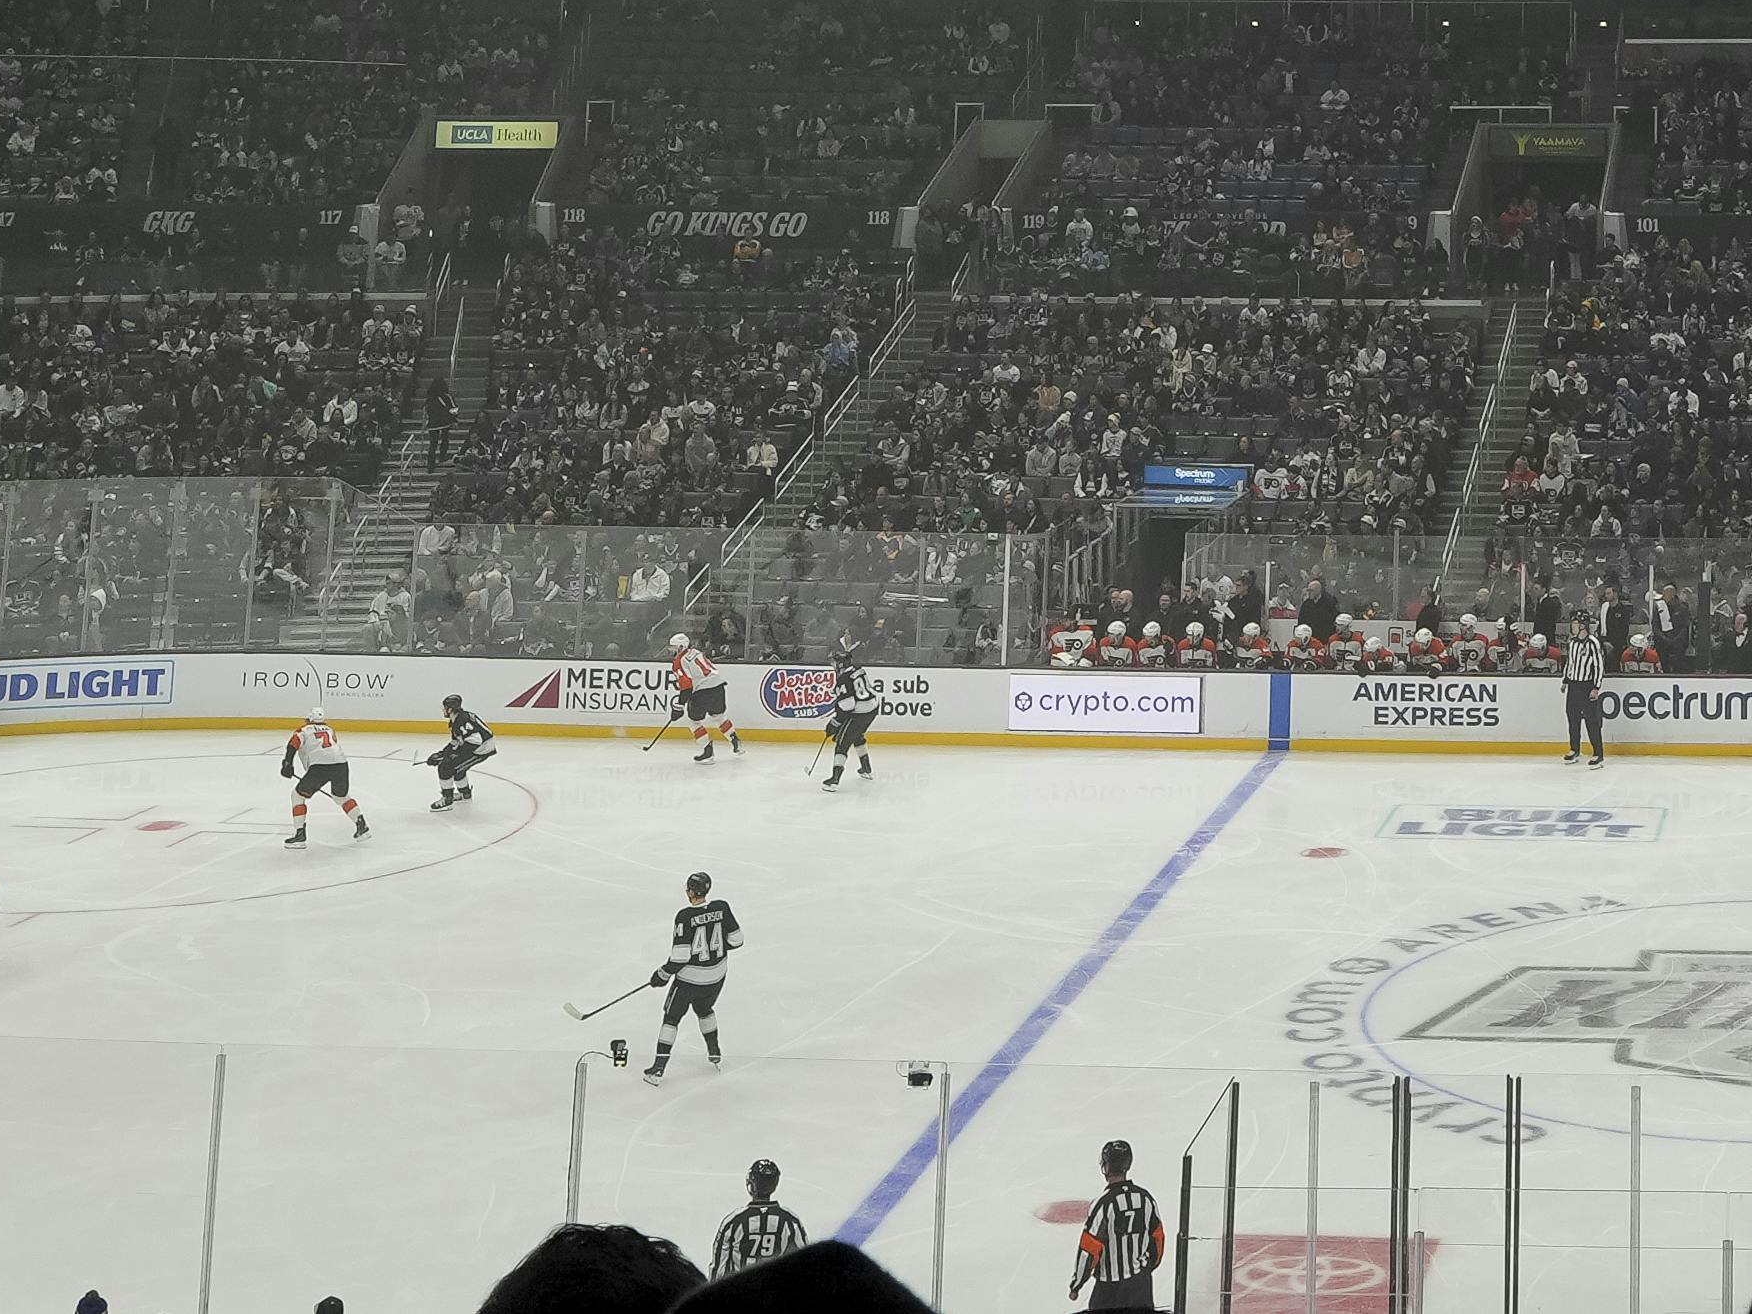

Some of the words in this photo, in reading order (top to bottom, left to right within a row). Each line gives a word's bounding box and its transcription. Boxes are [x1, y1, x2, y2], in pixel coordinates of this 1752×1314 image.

[457, 129, 488, 140] UCLA
[497, 129, 541, 141] Health
[688, 209, 762, 238] KINGS
[867, 210, 890, 226] 118
[1636, 217, 1660, 233] 101
[1175, 468, 1215, 479] Spectrum
[47, 668, 166, 700] LIGHT
[242, 671, 310, 688] IRON
[326, 673, 390, 690] BOW
[567, 668, 681, 690] MERCUR
[891, 675, 930, 693] sub
[1352, 683, 1497, 703] AMERICAN
[1040, 691, 1194, 722] crypto.com
[1374, 707, 1500, 727] EXPRESS
[1393, 820, 1646, 839] LIGHT
[692, 922, 723, 962] 44
